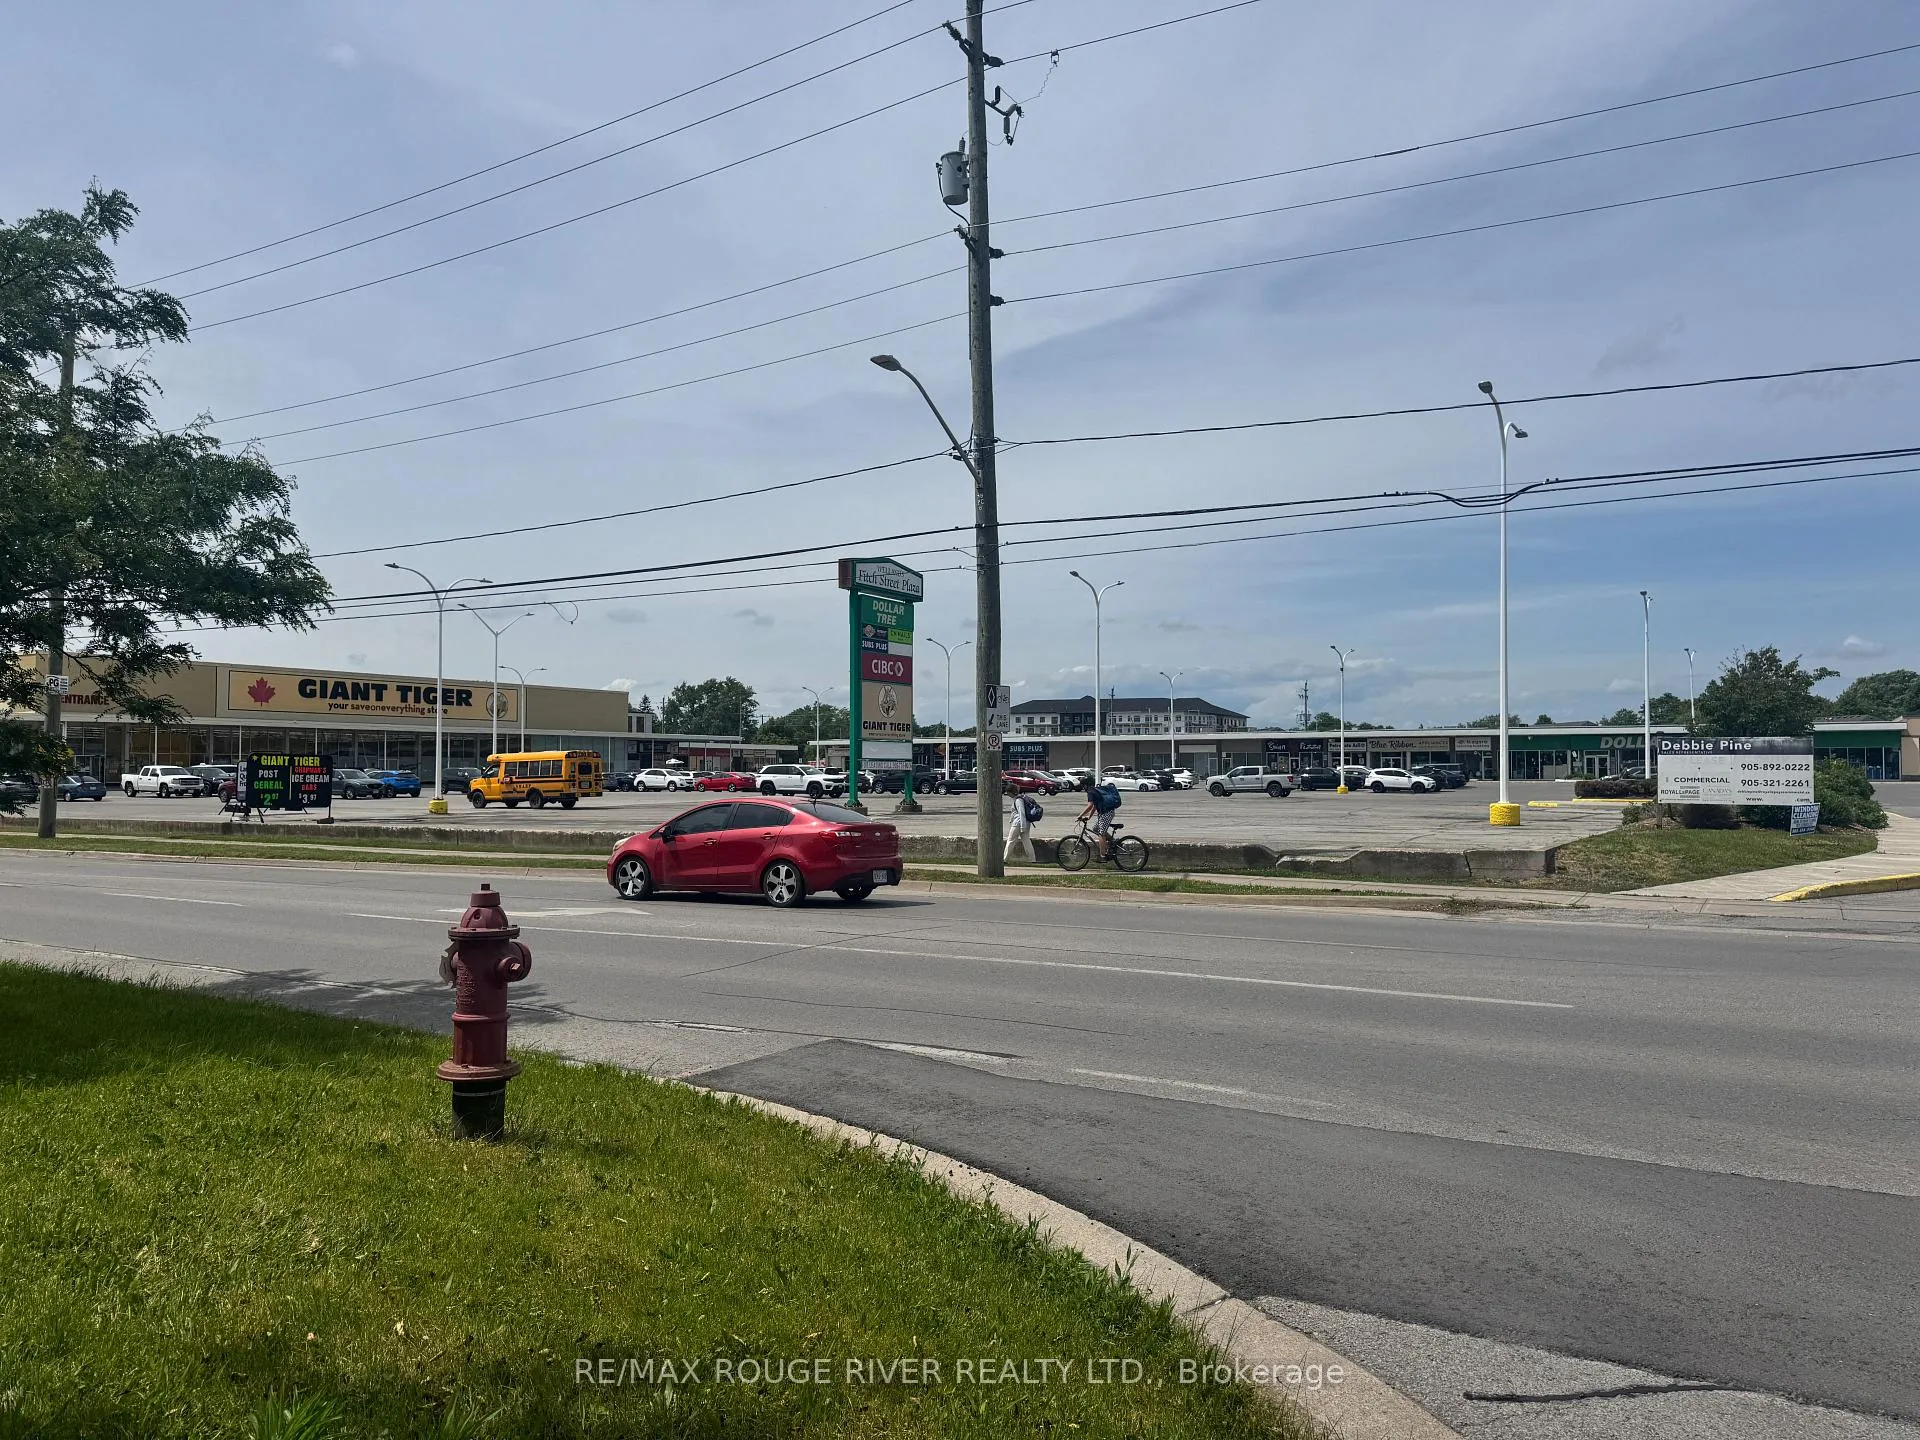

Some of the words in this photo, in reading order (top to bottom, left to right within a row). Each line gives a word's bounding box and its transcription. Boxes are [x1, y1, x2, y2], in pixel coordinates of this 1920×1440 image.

[859, 570, 878, 586] Fitch
[879, 574, 899, 591] Street
[902, 579, 920, 593] Plaza
[873, 601, 904, 615] DOLLAR
[877, 613, 897, 625] TREE
[862, 640, 874, 648] SUBS
[875, 642, 888, 650] PLUS
[872, 660, 894, 674] CIBC
[298, 679, 387, 701] GIANT
[396, 685, 473, 707] TIGER
[60, 694, 110, 705] ENTRANCE
[328, 702, 349, 711] your
[350, 703, 425, 716] saveoneverything
[427, 706, 448, 714] ste
[863, 720, 887, 731] GIANT
[889, 723, 911, 732] TIGER
[1661, 740, 1714, 751] Debbie
[1720, 740, 1752, 751] Pine
[260, 755, 290, 766] GIANT
[294, 756, 321, 767] TIGER
[1740, 763, 1811, 772] 905-892-0222
[258, 769, 279, 778] POST
[291, 774, 304, 783] ICE
[305, 774, 330, 783] CREAM
[253, 781, 284, 790] CEREAL
[1740, 779, 1810, 787] 905-321-2261
